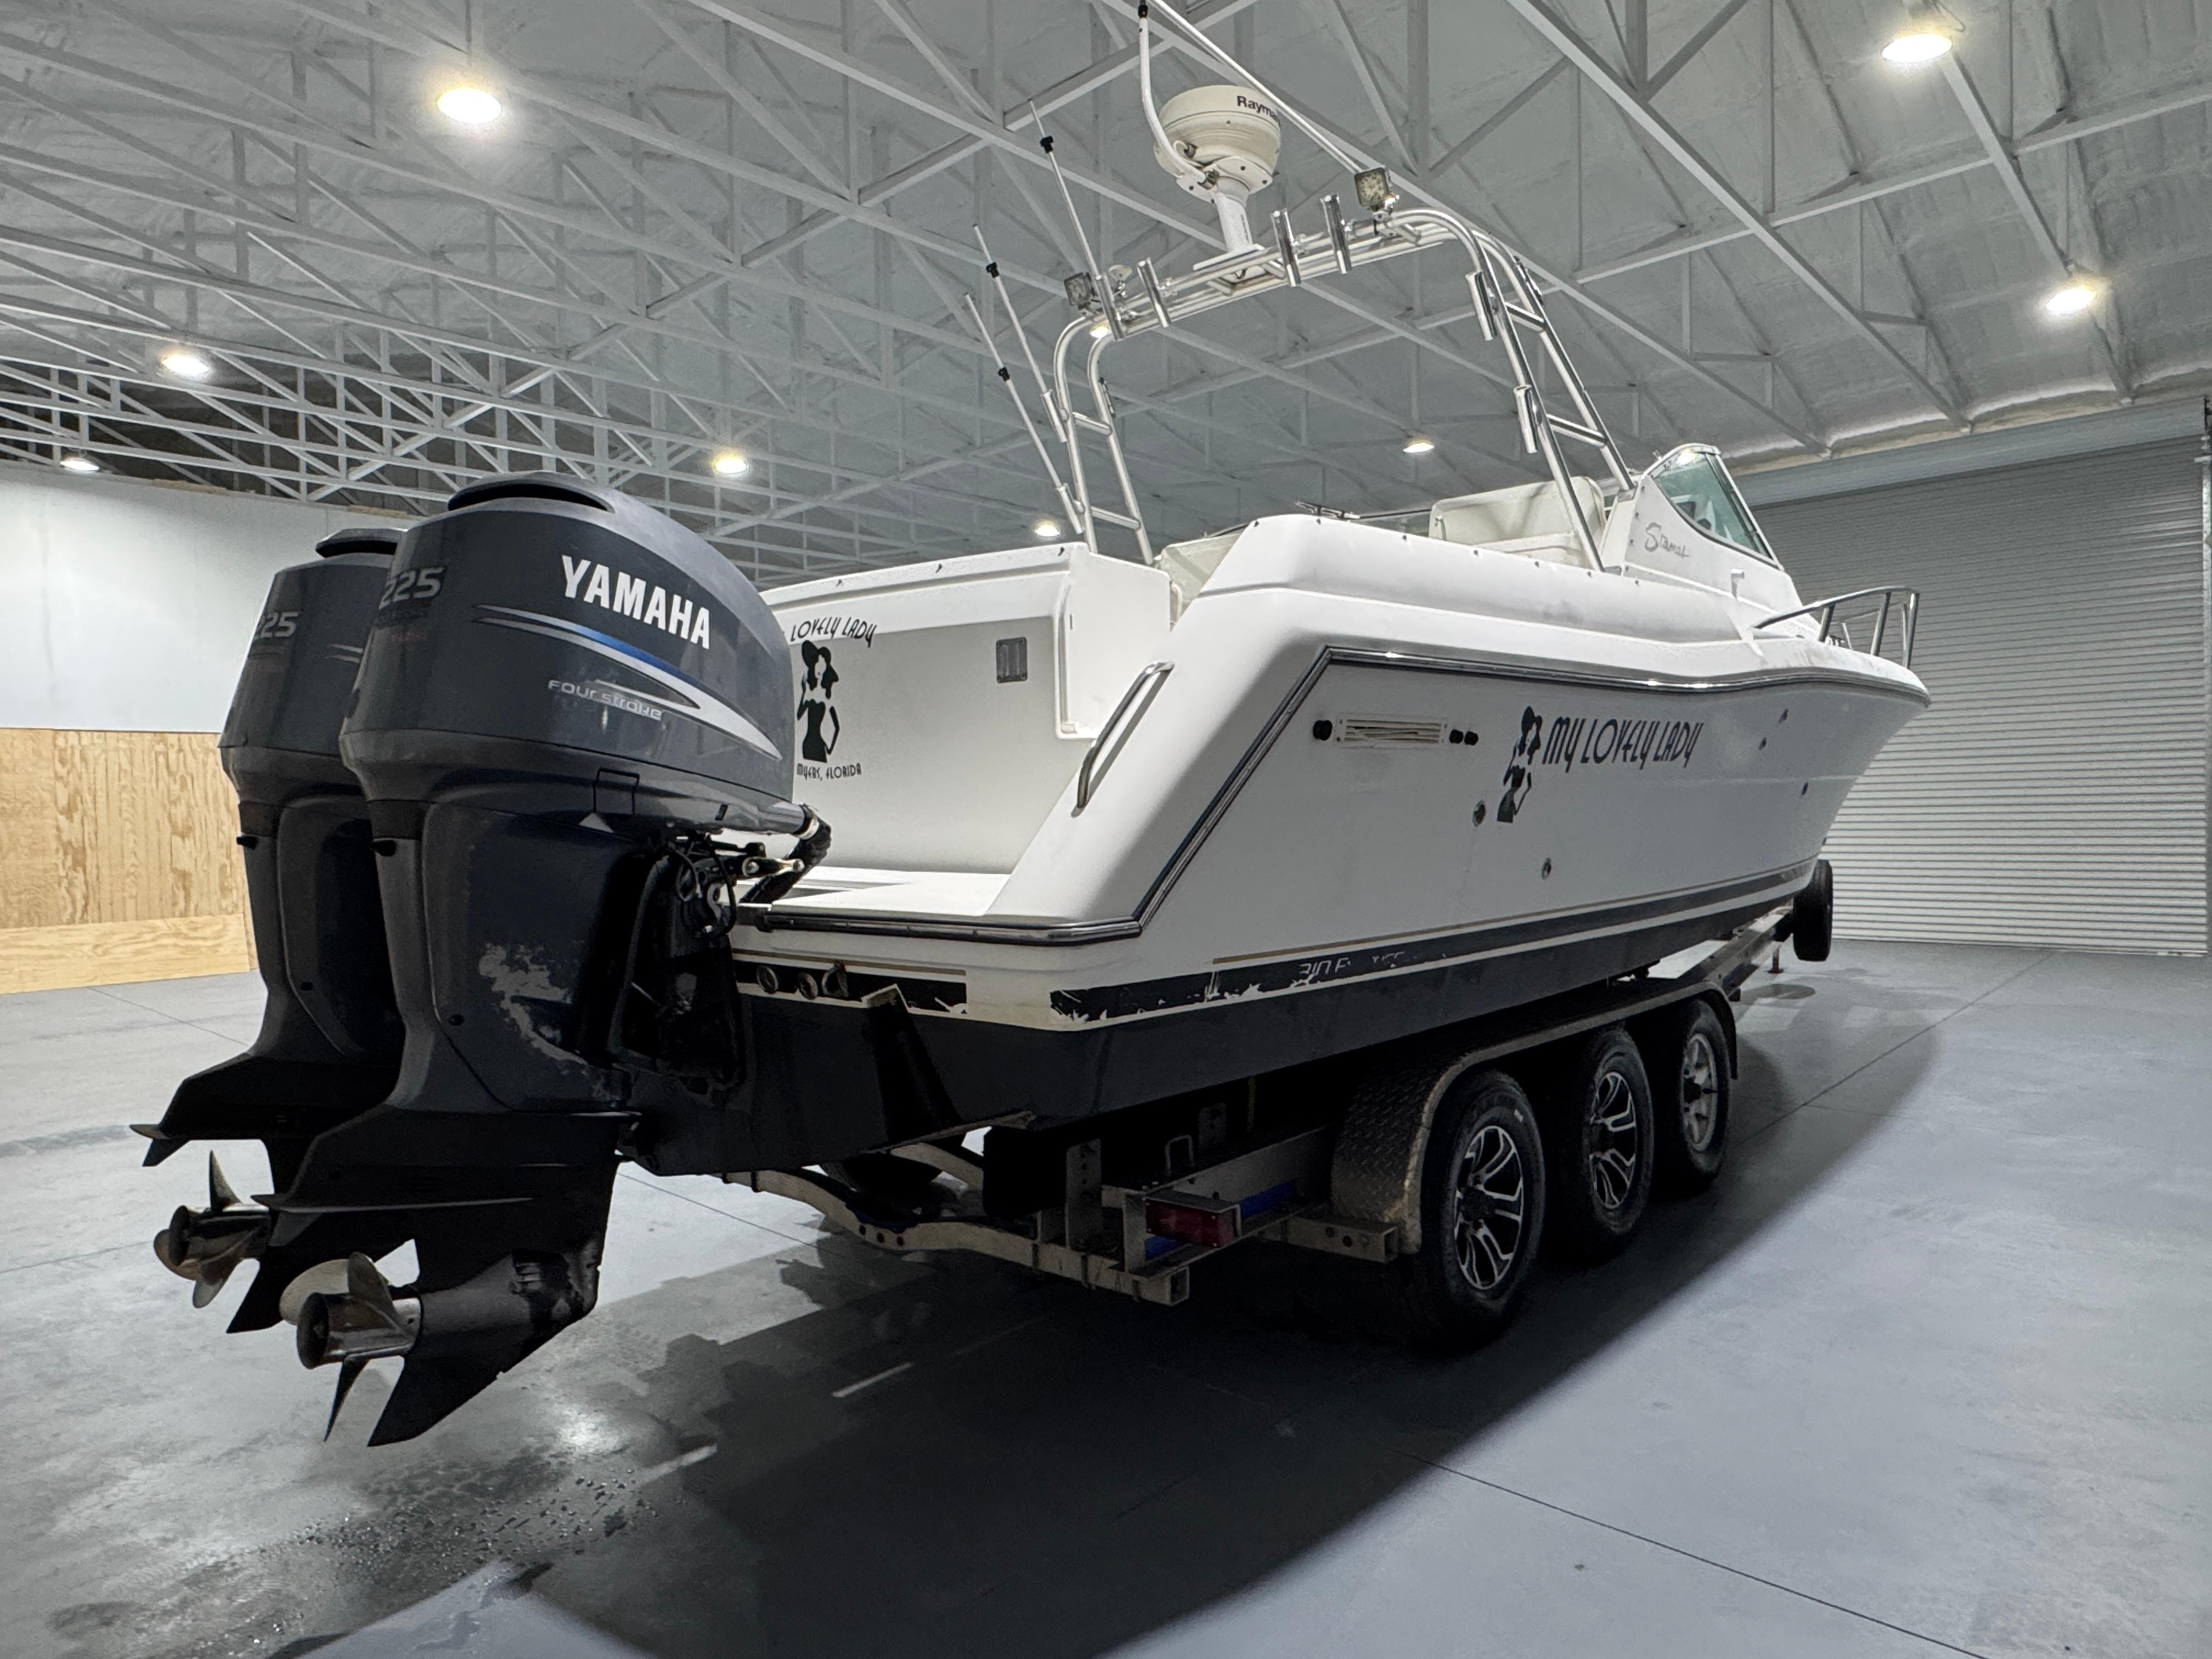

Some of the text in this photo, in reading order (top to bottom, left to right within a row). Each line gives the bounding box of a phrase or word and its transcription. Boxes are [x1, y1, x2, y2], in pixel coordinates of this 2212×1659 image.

[379, 567, 445, 610] 225
[562, 555, 710, 650] YAMAHA
[790, 616, 878, 648] LOVELY LADY
[1542, 716, 1705, 774] MY LOVELY LADY
[826, 763, 861, 780] FLORIDA
